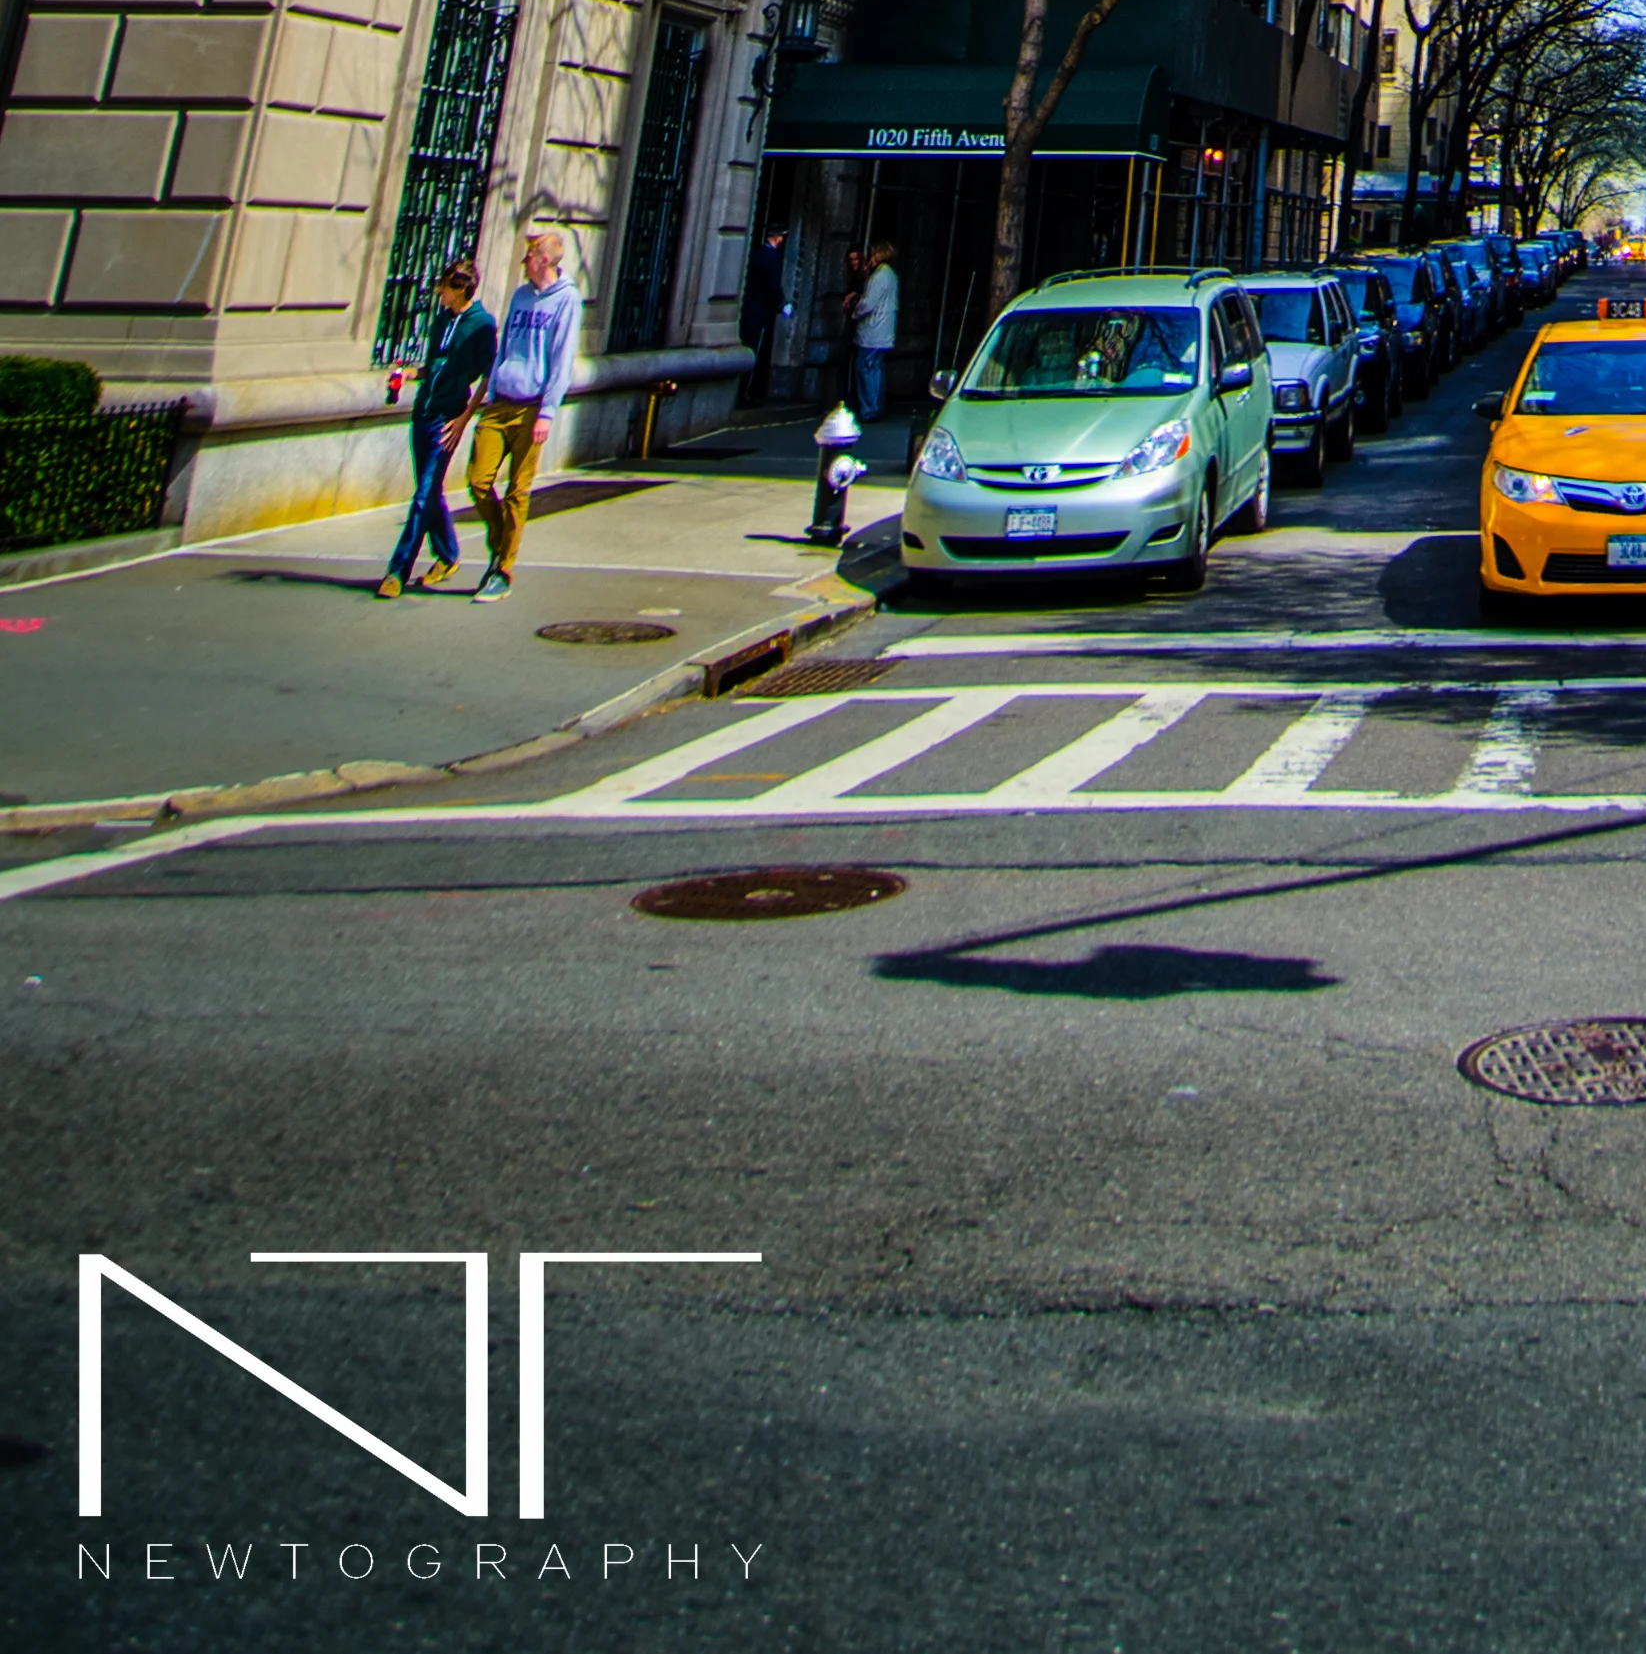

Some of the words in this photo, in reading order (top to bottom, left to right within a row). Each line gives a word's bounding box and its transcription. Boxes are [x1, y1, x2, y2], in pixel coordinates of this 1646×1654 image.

[867, 128, 908, 147] 1020
[911, 128, 952, 147] Fifth
[1611, 301, 1641, 318] 3C48
